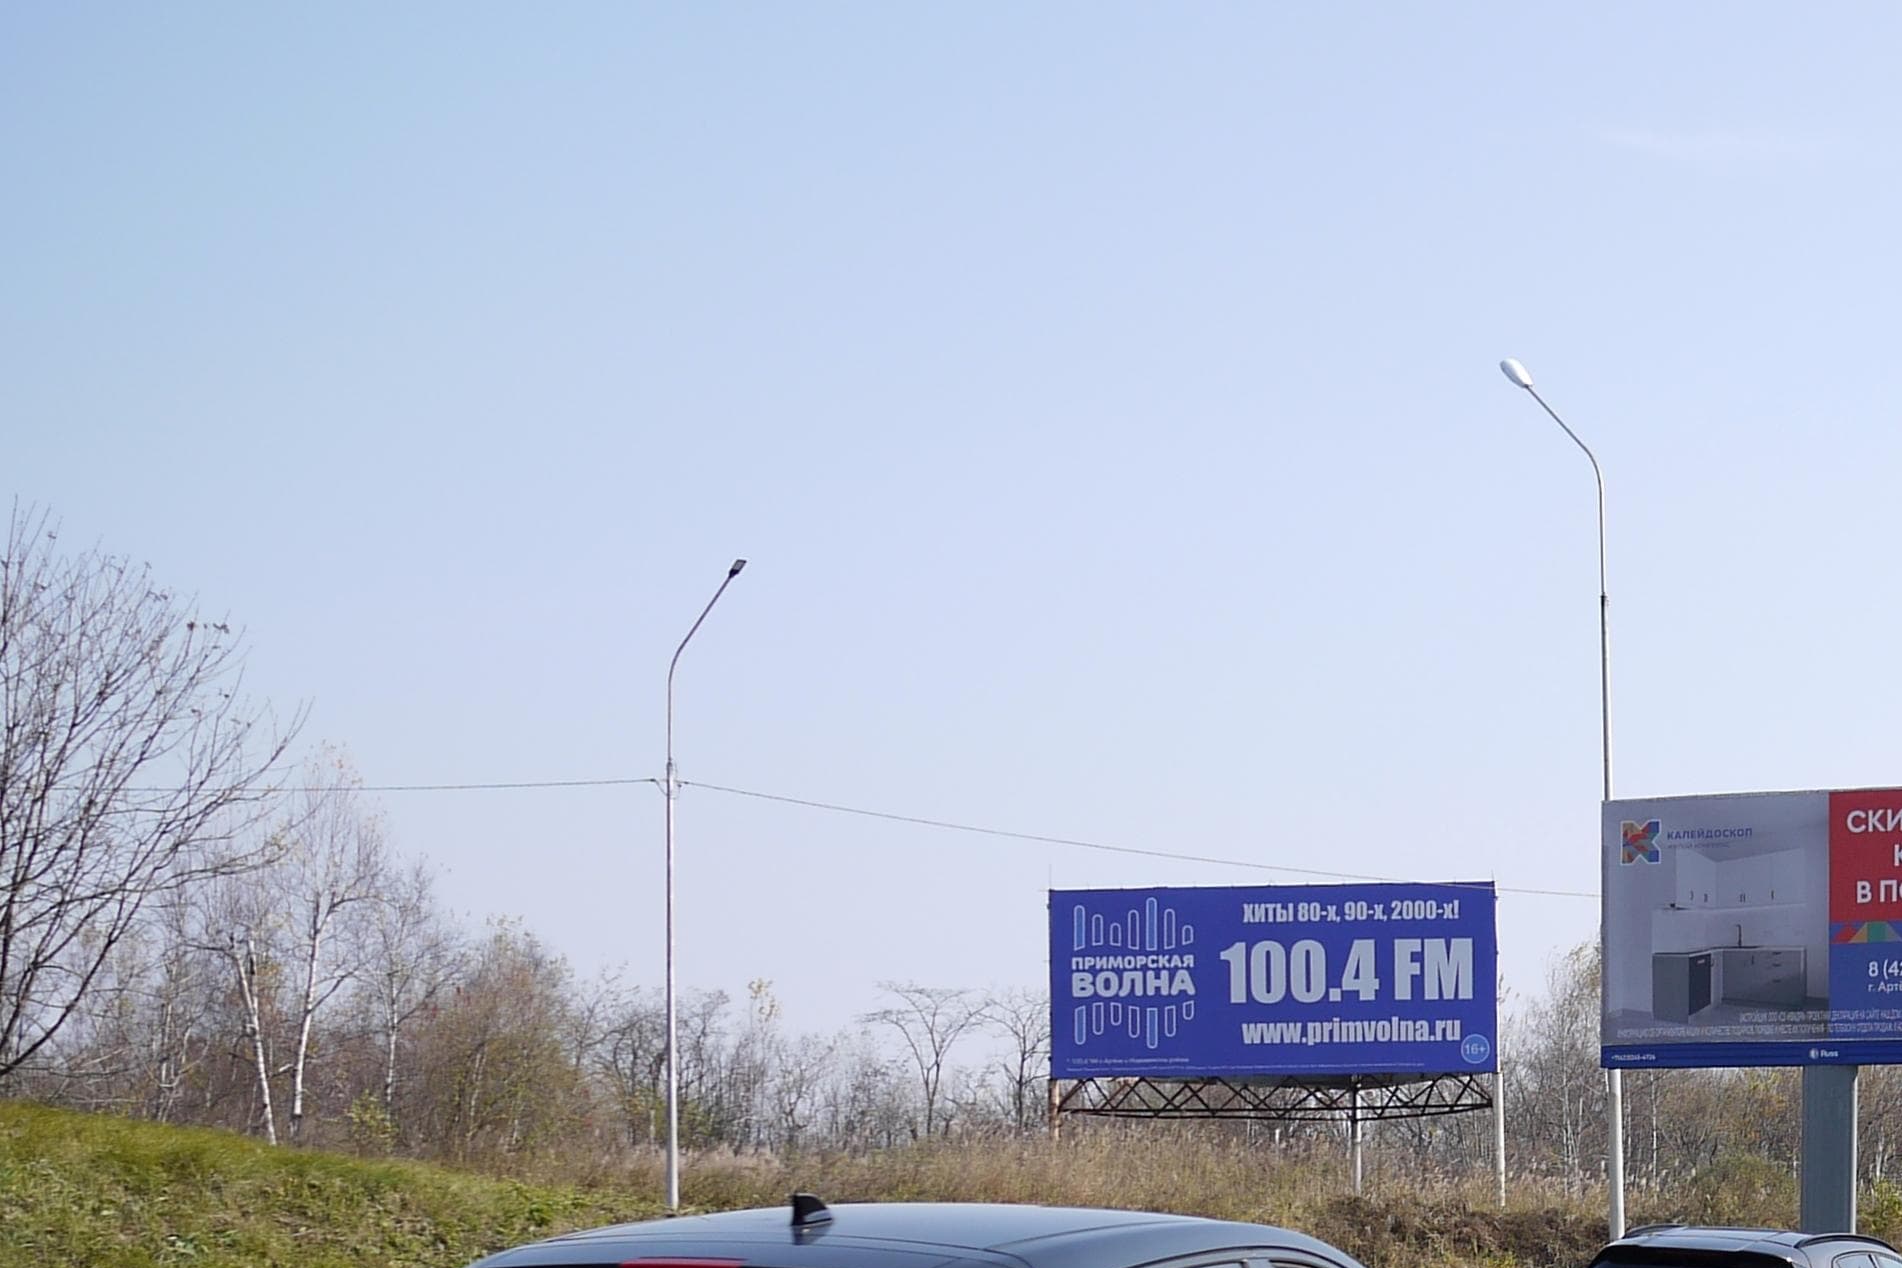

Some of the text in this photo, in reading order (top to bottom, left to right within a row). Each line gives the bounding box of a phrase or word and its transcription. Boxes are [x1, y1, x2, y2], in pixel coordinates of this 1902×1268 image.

[1667, 827, 1752, 841] КАЛЕЙДОСКОП
[1856, 880, 1872, 903] В
[1243, 899, 1460, 923] ХИТЫ 80-х, 90-х, 2000-х!
[1071, 954, 1195, 970] ПРИМОРСКАЯ
[1219, 937, 1473, 1004] 100.4 FM
[1868, 960, 1879, 977] 8
[1072, 969, 1196, 997] ВОЛНА
[1241, 1016, 1462, 1046] www.primvolna.ru
[1464, 1042, 1486, 1056] 16+
